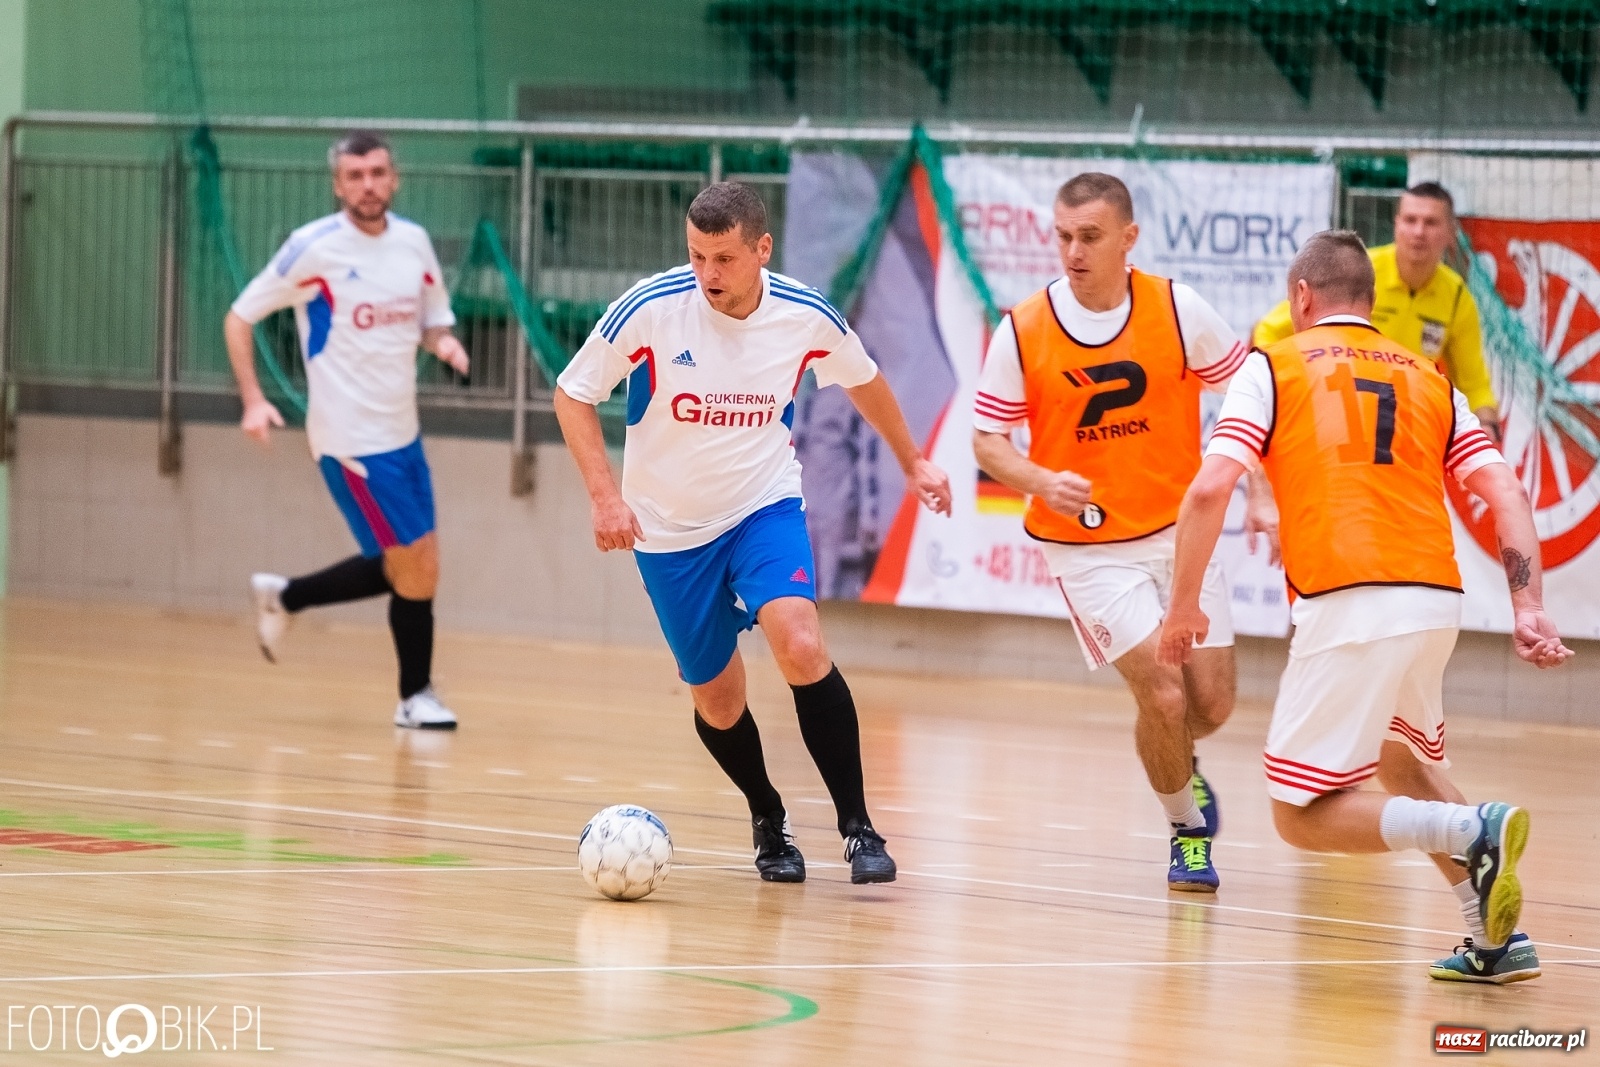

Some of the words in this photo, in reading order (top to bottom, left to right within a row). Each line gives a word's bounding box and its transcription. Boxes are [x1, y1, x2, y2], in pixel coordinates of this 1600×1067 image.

[956, 204, 1056, 246] PRIM
[1162, 212, 1301, 255] WORK
[671, 358, 697, 368] adidas
[1329, 345, 1420, 370] PATRICK
[671, 392, 775, 427] Gianni
[704, 393, 776, 405] CUKIERNIA
[1075, 418, 1151, 443] PATRICK
[1083, 501, 1102, 529] 6
